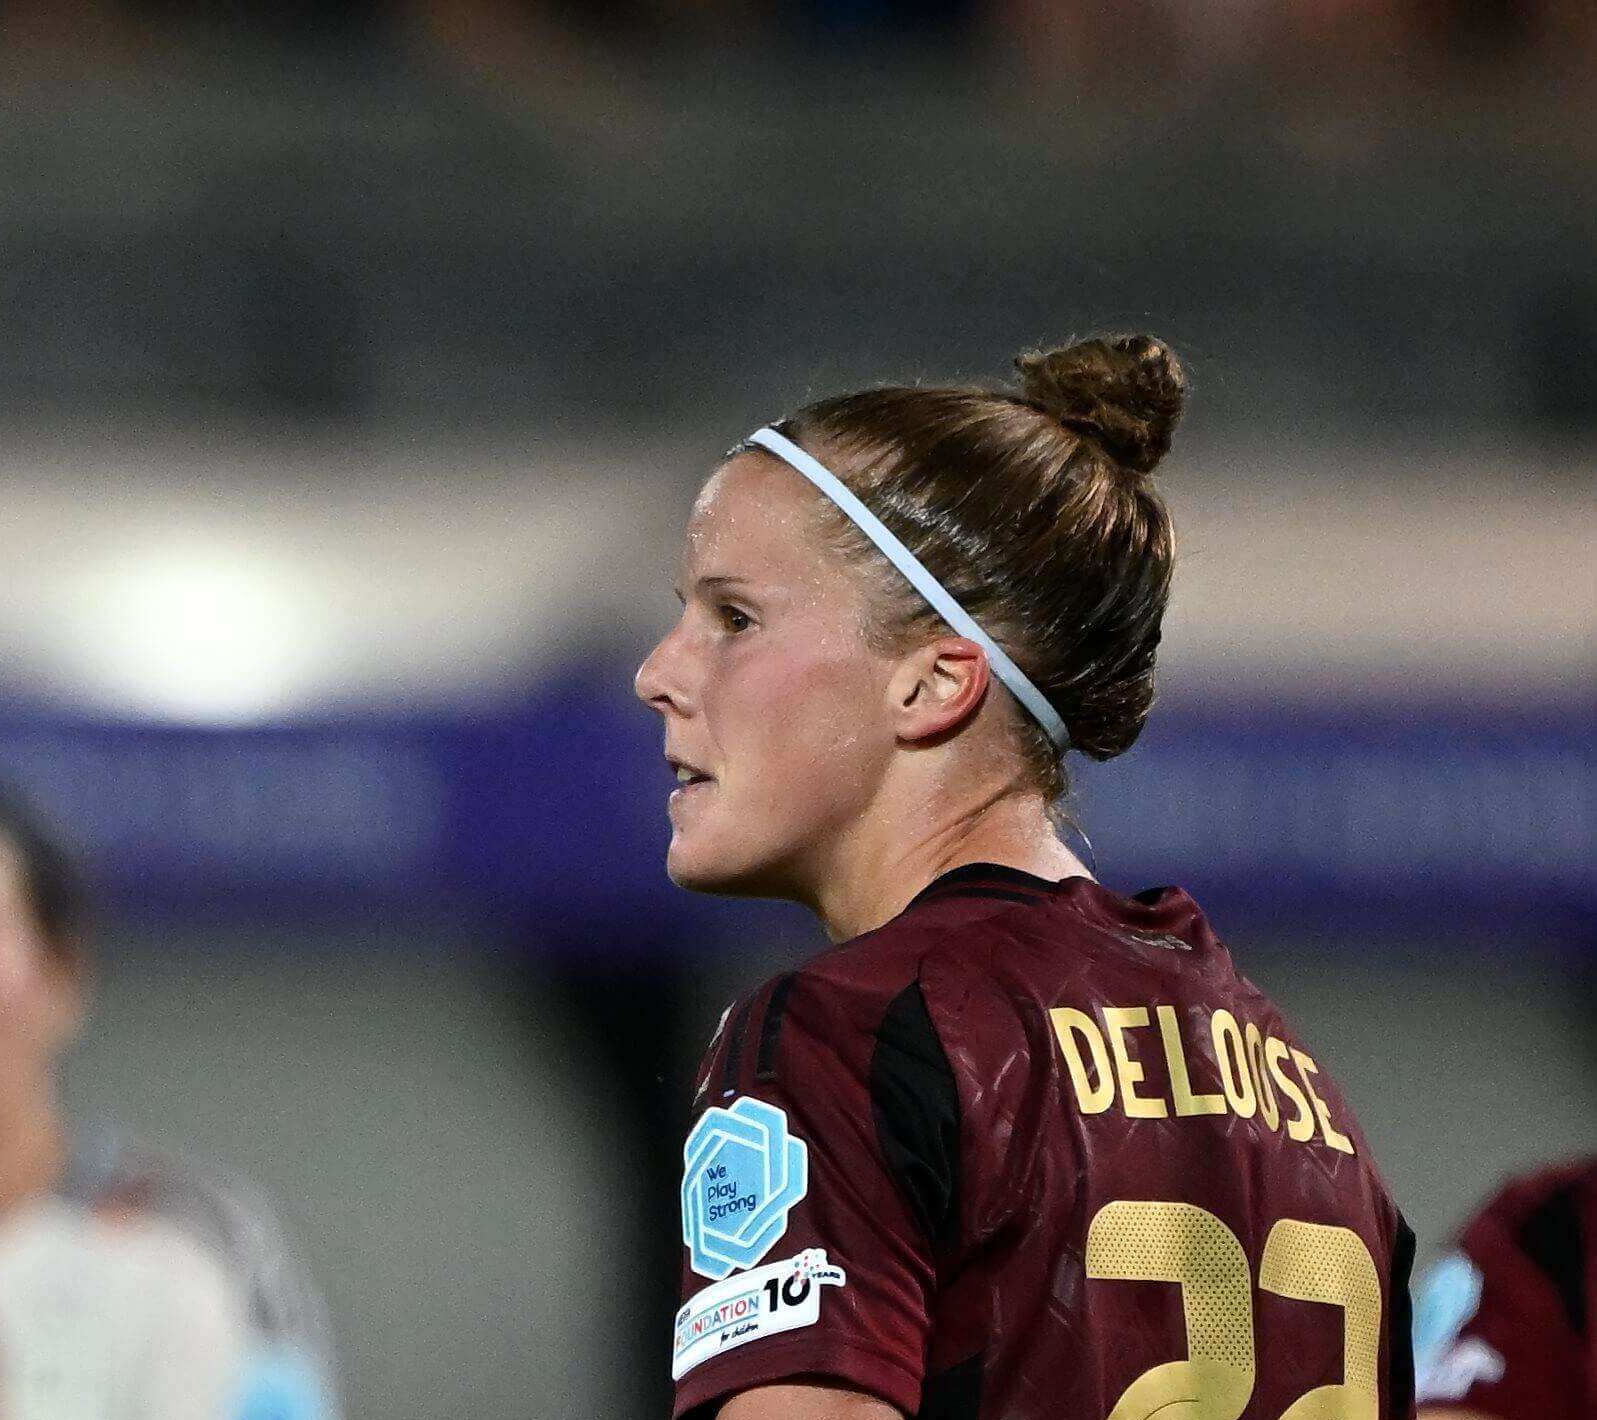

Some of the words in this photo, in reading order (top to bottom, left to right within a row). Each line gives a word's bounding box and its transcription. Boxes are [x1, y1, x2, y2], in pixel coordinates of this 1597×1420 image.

[1049, 1005, 1355, 1155] DELOOSE
[707, 1164, 726, 1181] We
[708, 1182, 736, 1203] Play
[709, 1194, 756, 1221] Strong
[764, 1278, 811, 1312] 10
